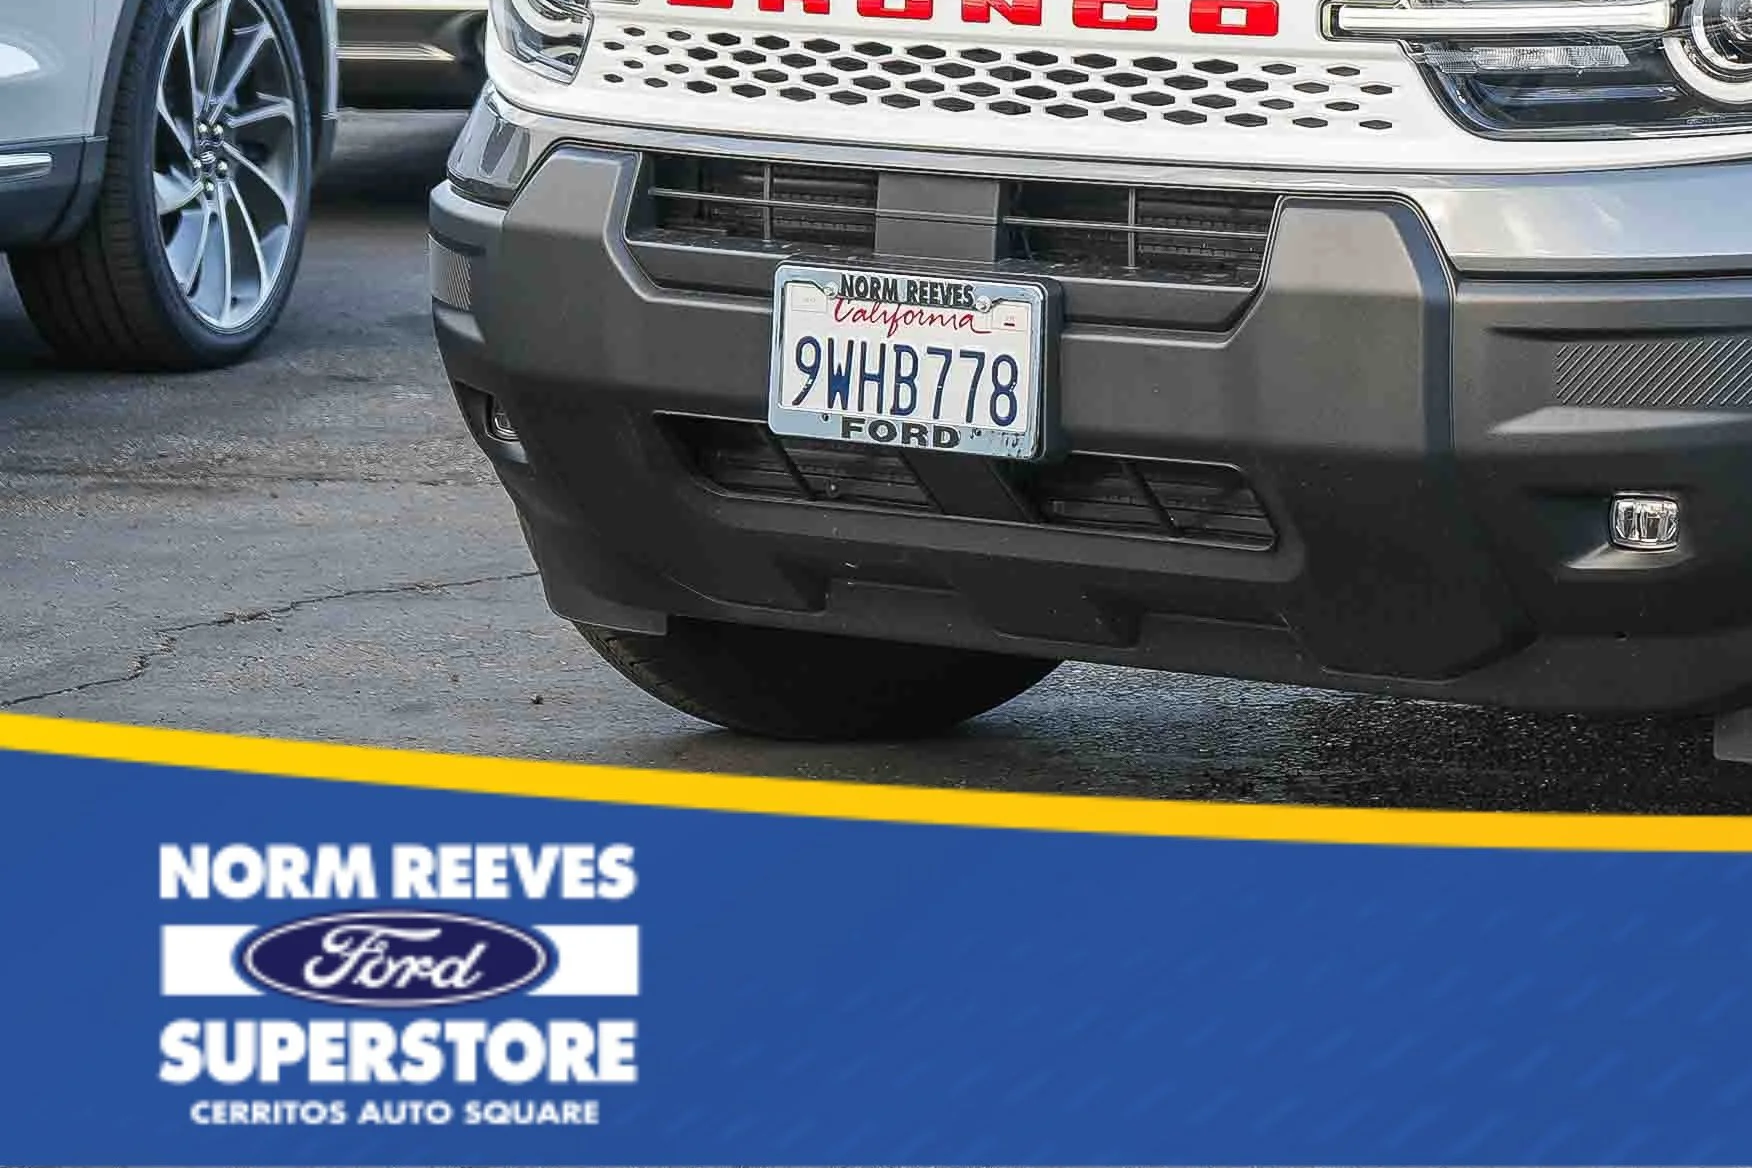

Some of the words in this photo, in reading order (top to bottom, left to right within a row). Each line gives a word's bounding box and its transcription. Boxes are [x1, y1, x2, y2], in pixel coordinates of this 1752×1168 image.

[838, 273, 898, 303] NORM
[906, 279, 975, 308] REEVES
[832, 297, 993, 338] California
[791, 335, 1019, 427] 9WHB778
[841, 417, 961, 449] FORD
